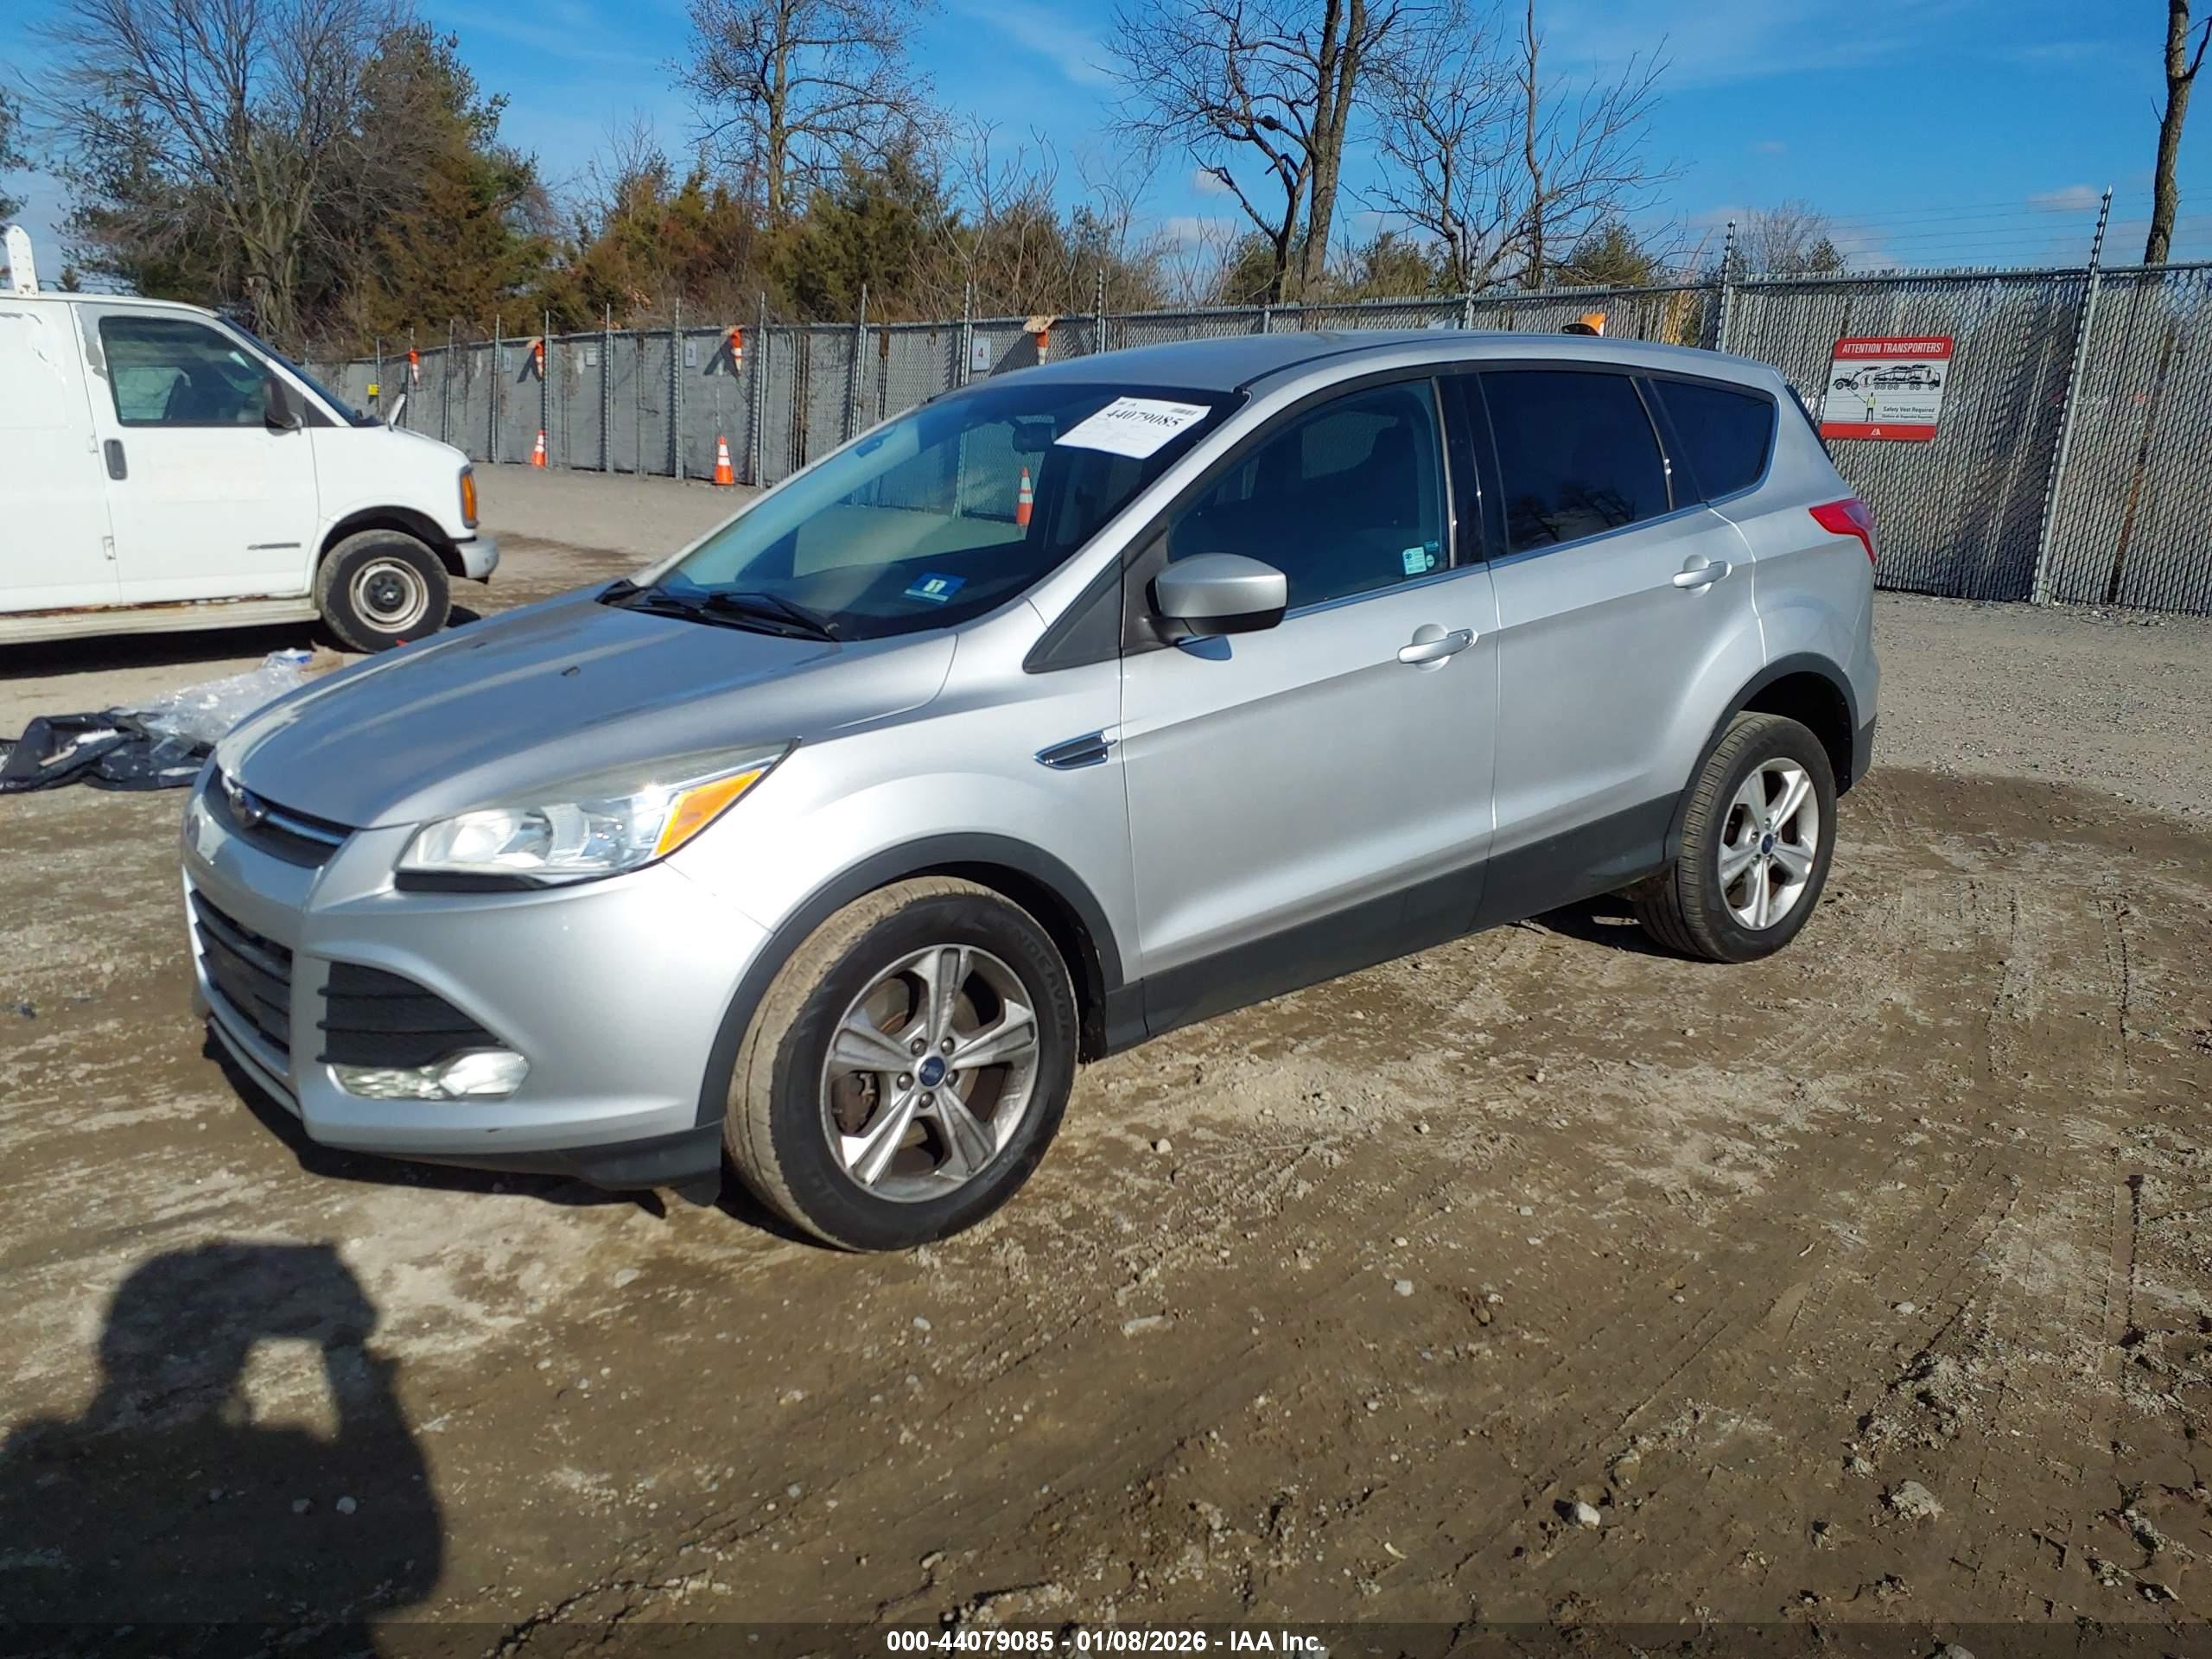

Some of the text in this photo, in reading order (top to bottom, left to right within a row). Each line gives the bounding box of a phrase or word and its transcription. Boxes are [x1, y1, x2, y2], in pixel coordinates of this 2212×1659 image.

[1841, 342, 1944, 353] ATTENTION TRANSPORTERS!
[1107, 409, 1184, 427] 44079085
